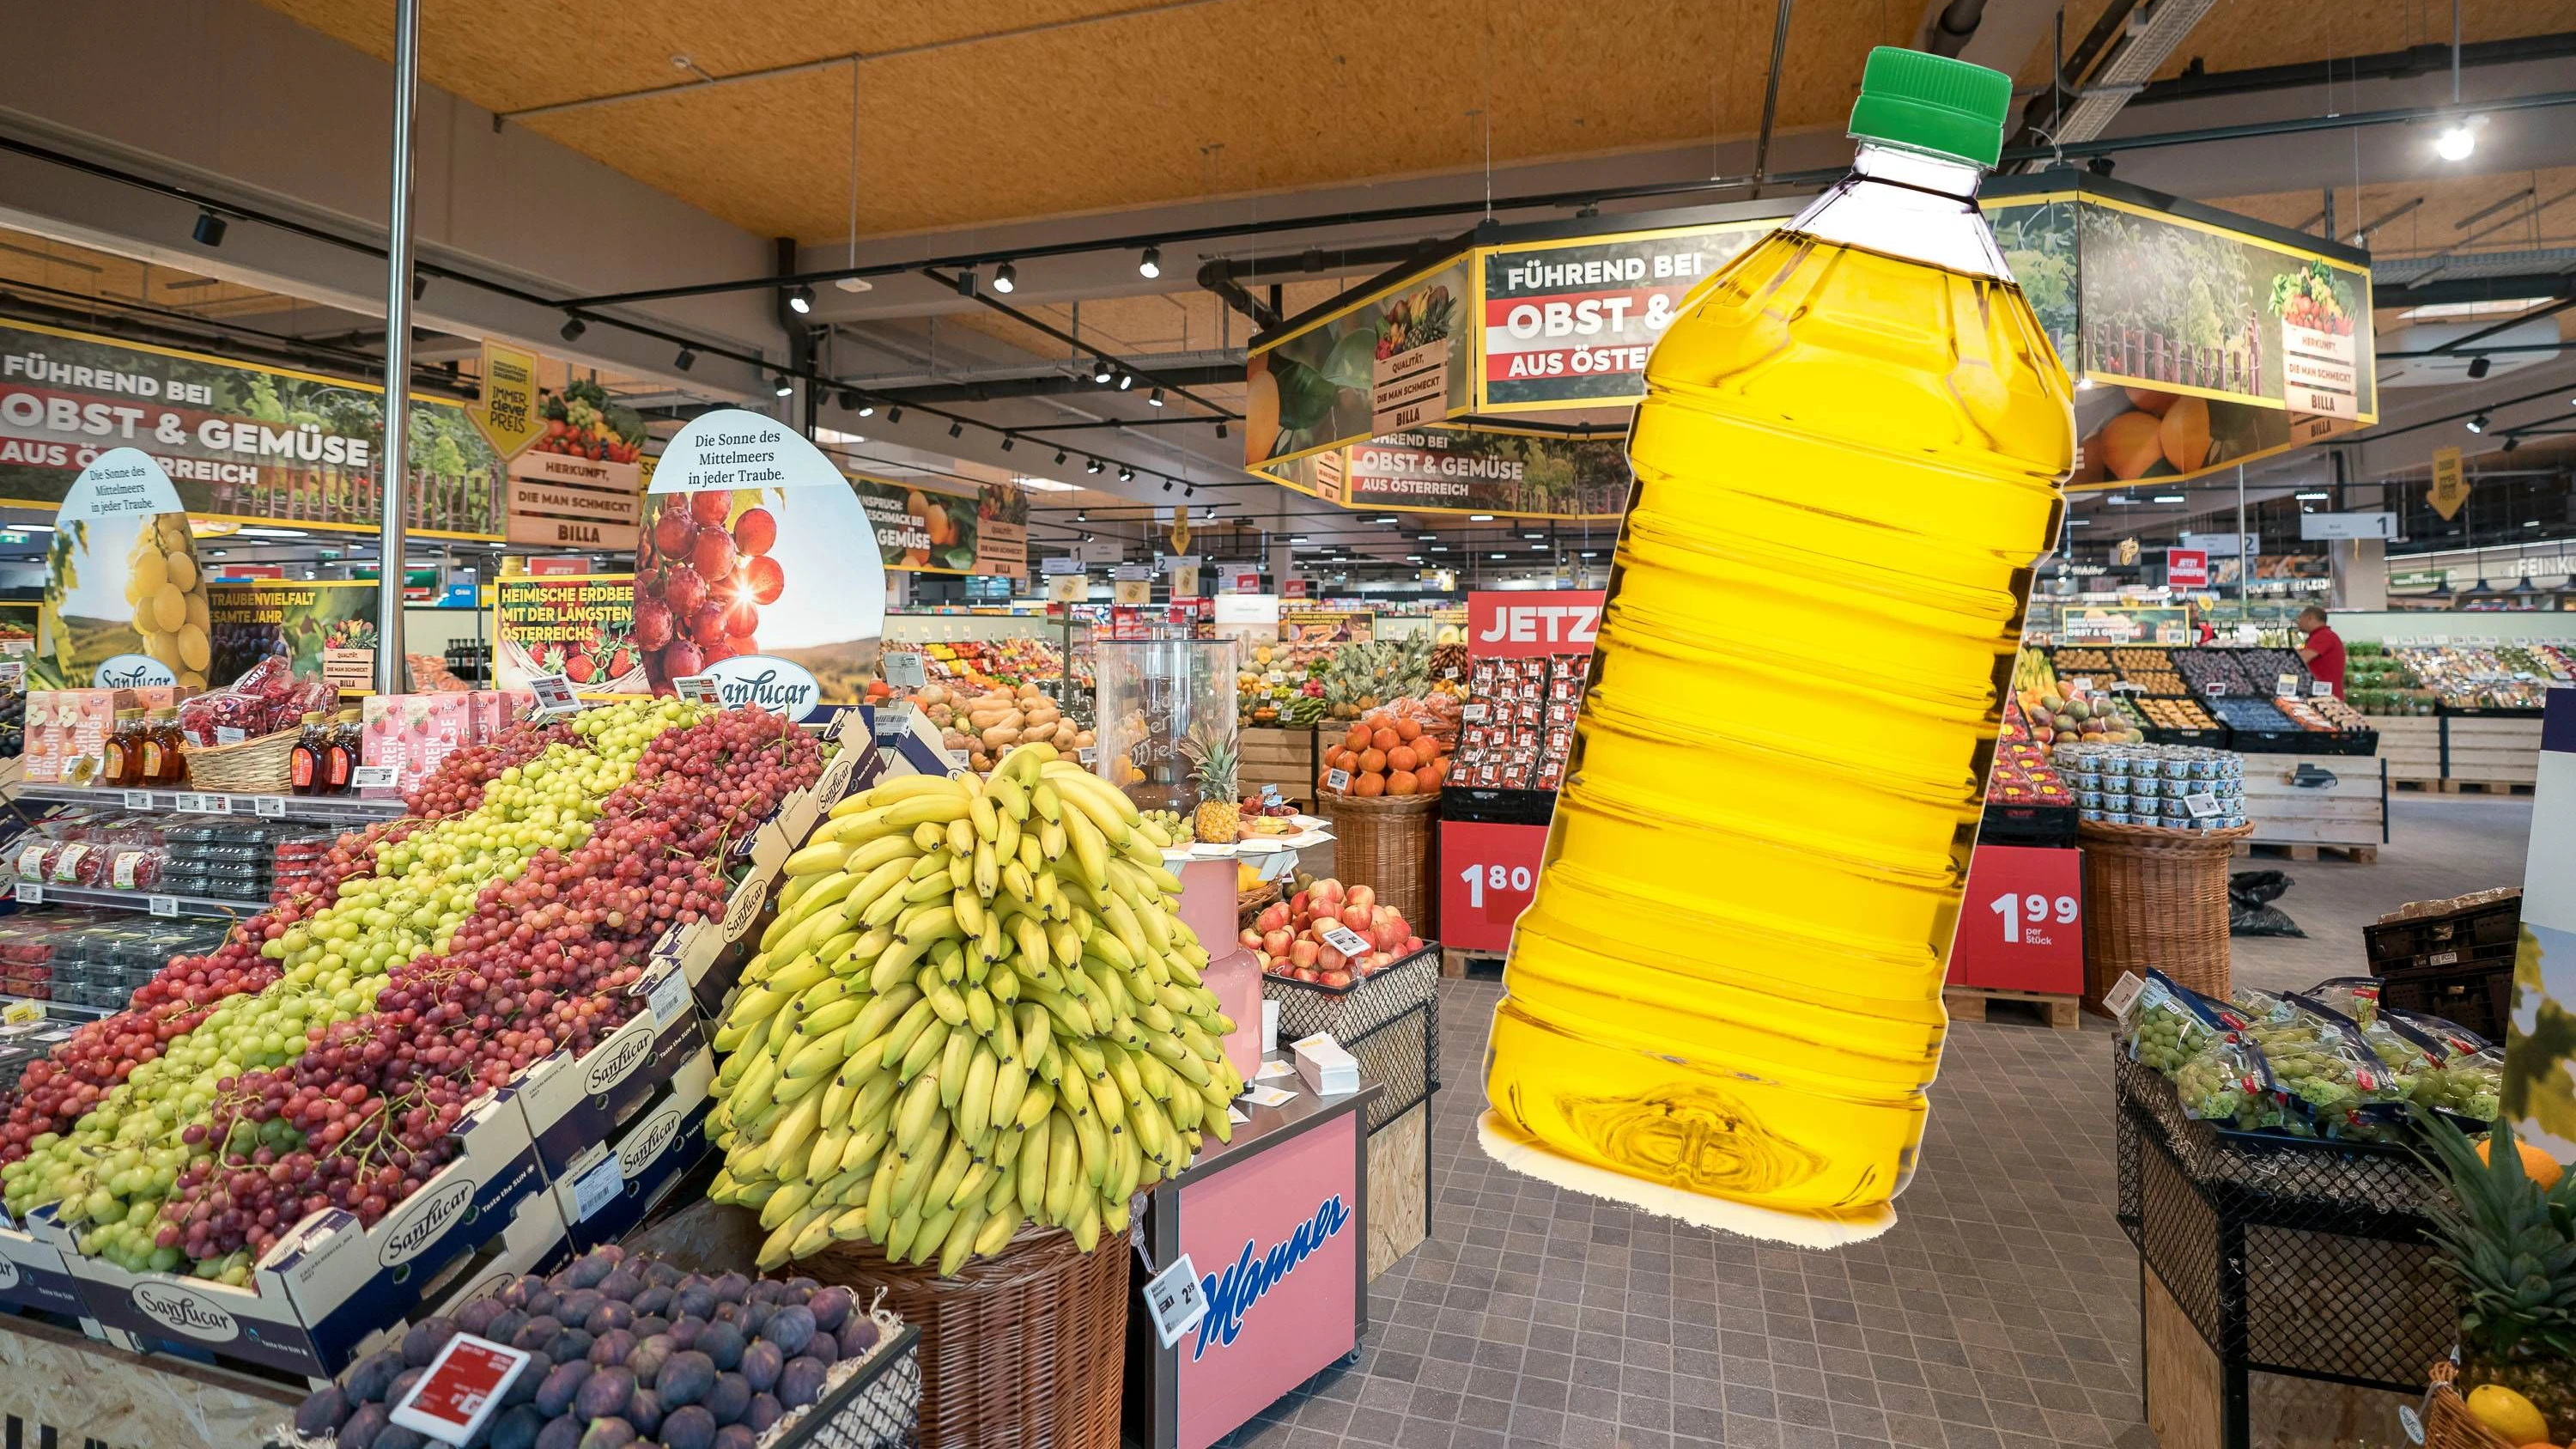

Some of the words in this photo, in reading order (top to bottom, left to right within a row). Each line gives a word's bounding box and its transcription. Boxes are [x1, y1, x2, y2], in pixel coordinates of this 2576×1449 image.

[1508, 259, 1646, 290] FÜHREND
[1654, 253, 1702, 278] BEI
[1507, 296, 1632, 340] OBST
[1643, 294, 1676, 331] &
[1509, 352, 1564, 378] AUS
[1571, 344, 1652, 373] ÖSTE
[3, 352, 160, 397] FÜHREND
[167, 381, 212, 405] BEI
[2289, 363, 2300, 374] DIE
[2301, 366, 2316, 377] MAN
[2318, 368, 2351, 383] SCHMECKT
[492, 386, 529, 408] IMMER
[1377, 393, 1387, 404] DIE
[1388, 388, 1402, 400] MAN
[1404, 376, 1440, 395] SCHMECKT
[491, 399, 527, 417] clever
[2312, 394, 2335, 411] BILLA
[490, 411, 526, 434] PREIS
[1396, 407, 1420, 426] BILLA
[1, 393, 145, 439] OBST
[155, 413, 187, 445] &
[197, 419, 369, 467] GEMÜSE
[2311, 419, 2331, 437] BILLA
[695, 435, 715, 447] Die
[719, 432, 756, 446] Sonne
[760, 430, 781, 443] des
[1428, 435, 1449, 448] BEI
[1, 441, 68, 466] AUS
[76, 441, 257, 485] ÖRREICH
[700, 449, 775, 466] Mittelmeers
[1362, 451, 1419, 473] OBST
[1423, 455, 1437, 474] &
[1441, 454, 1523, 481] GEMÜSE
[90, 470, 103, 482] Die
[105, 468, 130, 480] Sonne
[131, 466, 146, 478] des
[545, 461, 611, 481] HERKUNFT,
[689, 472, 701, 485] in
[702, 471, 734, 488] jeder
[738, 469, 785, 483] Traube.
[95, 484, 145, 496] Mittelmeers
[1362, 478, 1388, 492] AUS
[1390, 476, 1469, 496] ÖSTERREICH
[91, 502, 100, 513] in
[100, 500, 121, 514] jeder
[122, 498, 155, 511] Traube.
[518, 490, 538, 503] DIE
[542, 494, 568, 507] MAN
[571, 496, 633, 513] SCHMECKT
[860, 495, 903, 511] NSPRUCH:
[866, 510, 911, 526] ESCHMACK
[2377, 517, 2387, 535] 1
[558, 525, 600, 543] BILLA
[877, 526, 931, 551] GEMÜSE
[1076, 561, 1084, 571] 2
[1144, 568, 1151, 578] 3
[1158, 558, 1165, 570] 2
[212, 592, 316, 606] TRAUBENVIELFALT
[501, 588, 575, 602] HEIMISCHE
[209, 610, 251, 624] ESAMTE
[253, 610, 283, 624] JAHR
[501, 607, 526, 621] MIT
[527, 607, 555, 621] DER
[558, 602, 632, 621] LÄNGSTEN
[501, 622, 594, 642] ÖSTERREICHS
[1479, 606, 1603, 642] JETZ
[339, 679, 355, 688] BILLA
[714, 670, 811, 711] anLucar
[27, 755, 42, 776] BIO
[819, 764, 850, 809] SanLucar
[726, 885, 764, 938] SanLucar
[2026, 928, 2042, 937] per
[2026, 935, 2051, 945] Stück
[659, 1045, 674, 1059] Taste
[672, 1037, 683, 1048] the
[681, 1026, 692, 1039] SUN
[592, 1033, 651, 1089] SanLucar
[685, 1125, 701, 1140] Taste
[624, 1116, 677, 1174] SanLucar
[482, 1196, 501, 1213] Taste
[501, 1184, 513, 1199] the
[512, 1172, 527, 1188] SUN
[389, 1186, 469, 1260] SanLucar
[1188, 1195, 1350, 1362] Manner
[141, 1290, 228, 1330] SanLucar
